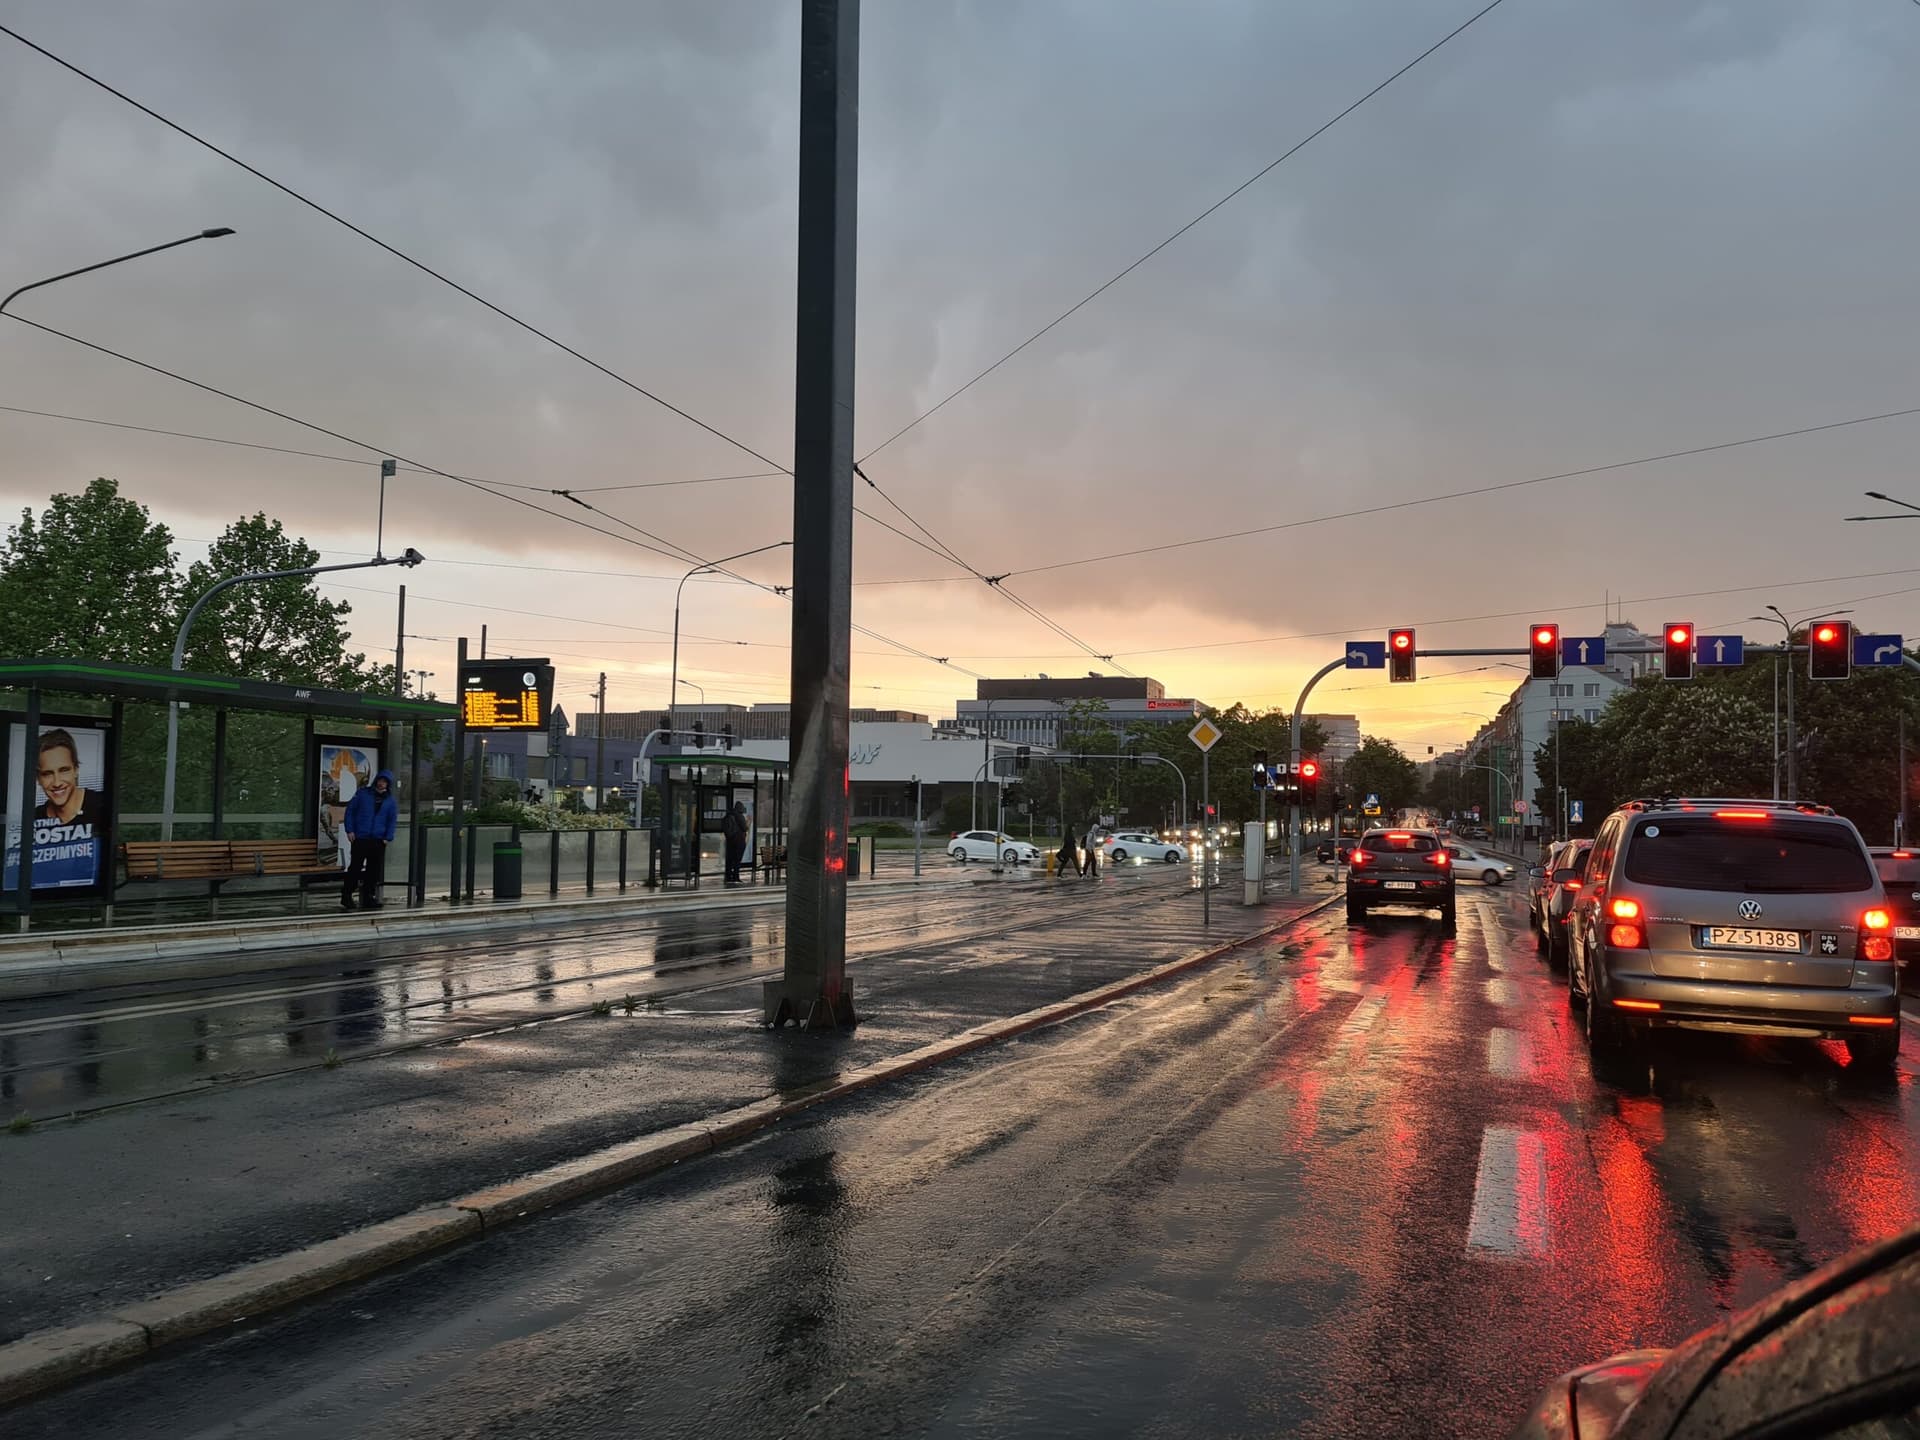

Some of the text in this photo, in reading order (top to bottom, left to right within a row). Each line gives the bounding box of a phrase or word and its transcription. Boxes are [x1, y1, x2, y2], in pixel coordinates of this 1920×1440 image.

[295, 689, 312, 699] AWF
[8, 823, 93, 849] POSTA!
[1713, 928, 1797, 948] PZ 5138S
